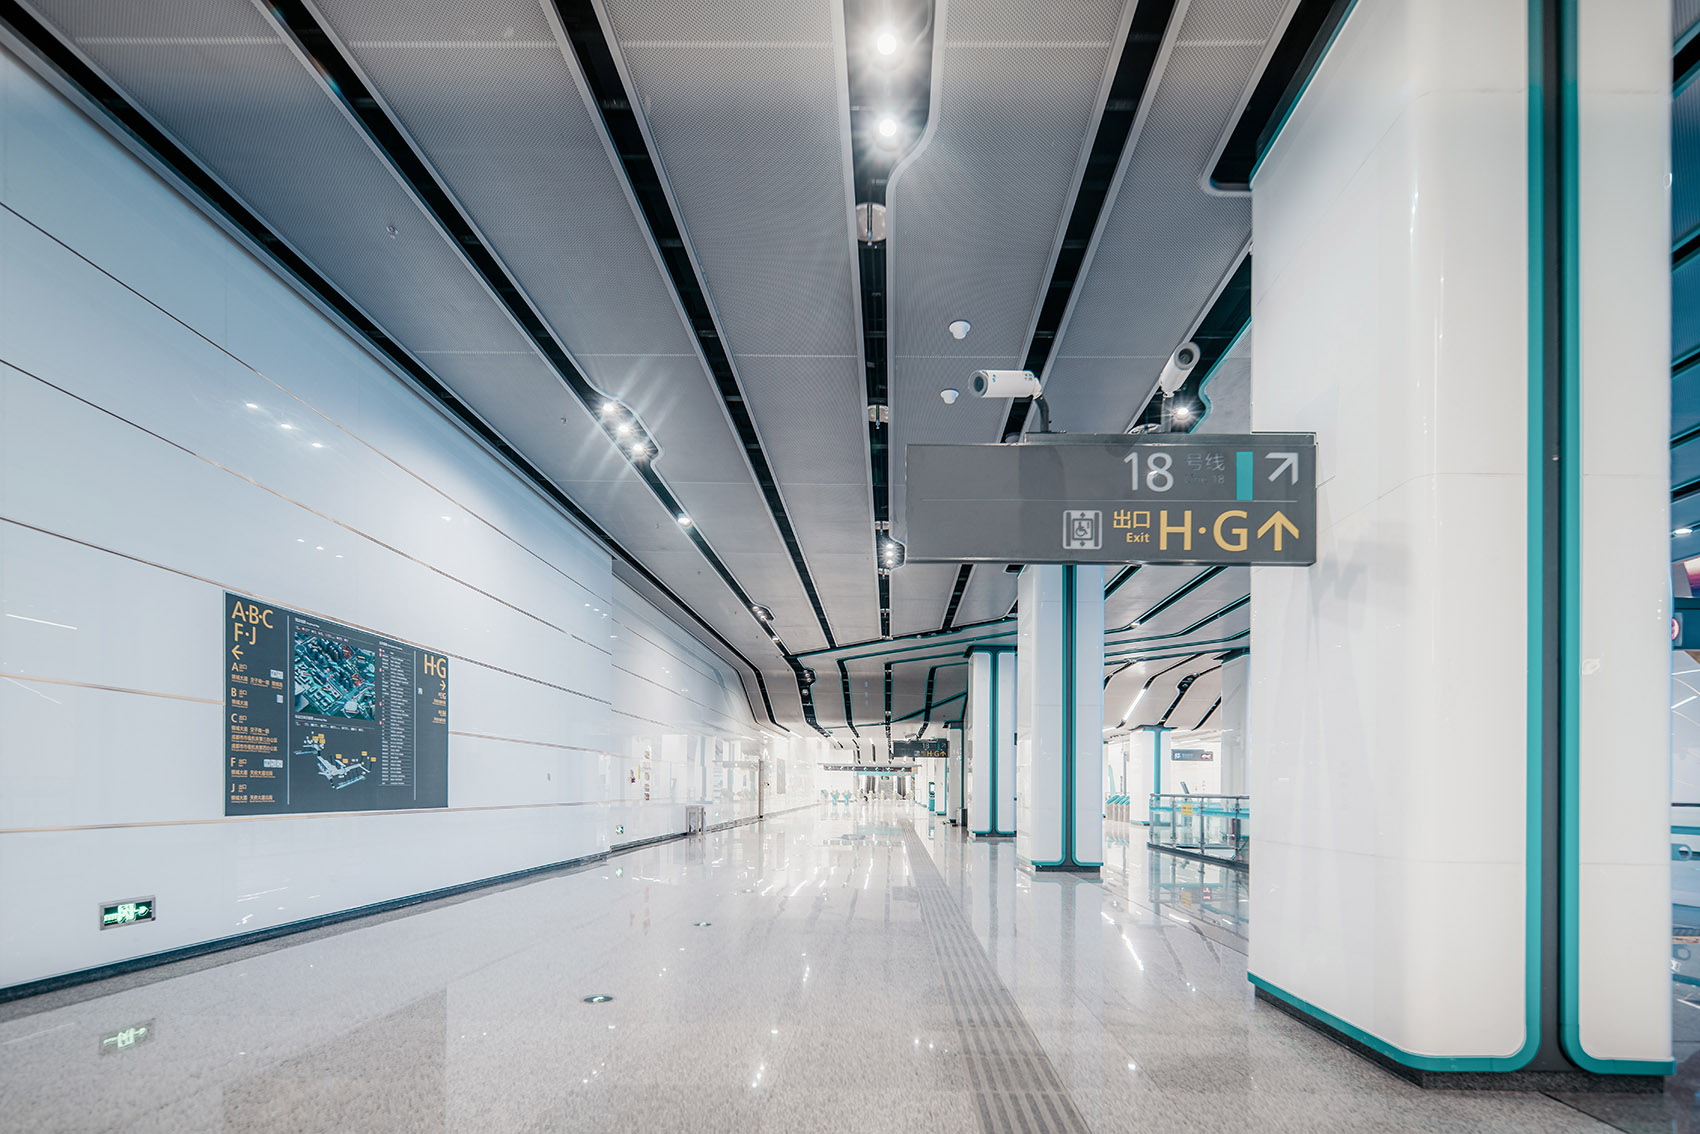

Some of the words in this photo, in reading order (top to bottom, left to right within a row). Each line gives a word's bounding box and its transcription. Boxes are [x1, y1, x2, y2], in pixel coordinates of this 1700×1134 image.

[1186, 452, 1226, 471] 号线
[1124, 452, 1174, 492] 18
[1213, 475, 1225, 484] 18
[1113, 509, 1150, 529] 出口
[1126, 532, 1150, 543] Exit
[1159, 510, 1248, 551] H·G
[232, 601, 273, 629] A·B·C
[234, 622, 256, 645] F·J
[231, 662, 239, 672] A
[424, 653, 447, 679] H·G
[231, 687, 237, 697] B
[231, 713, 238, 723] C
[230, 757, 236, 767] F
[230, 783, 235, 793] J
